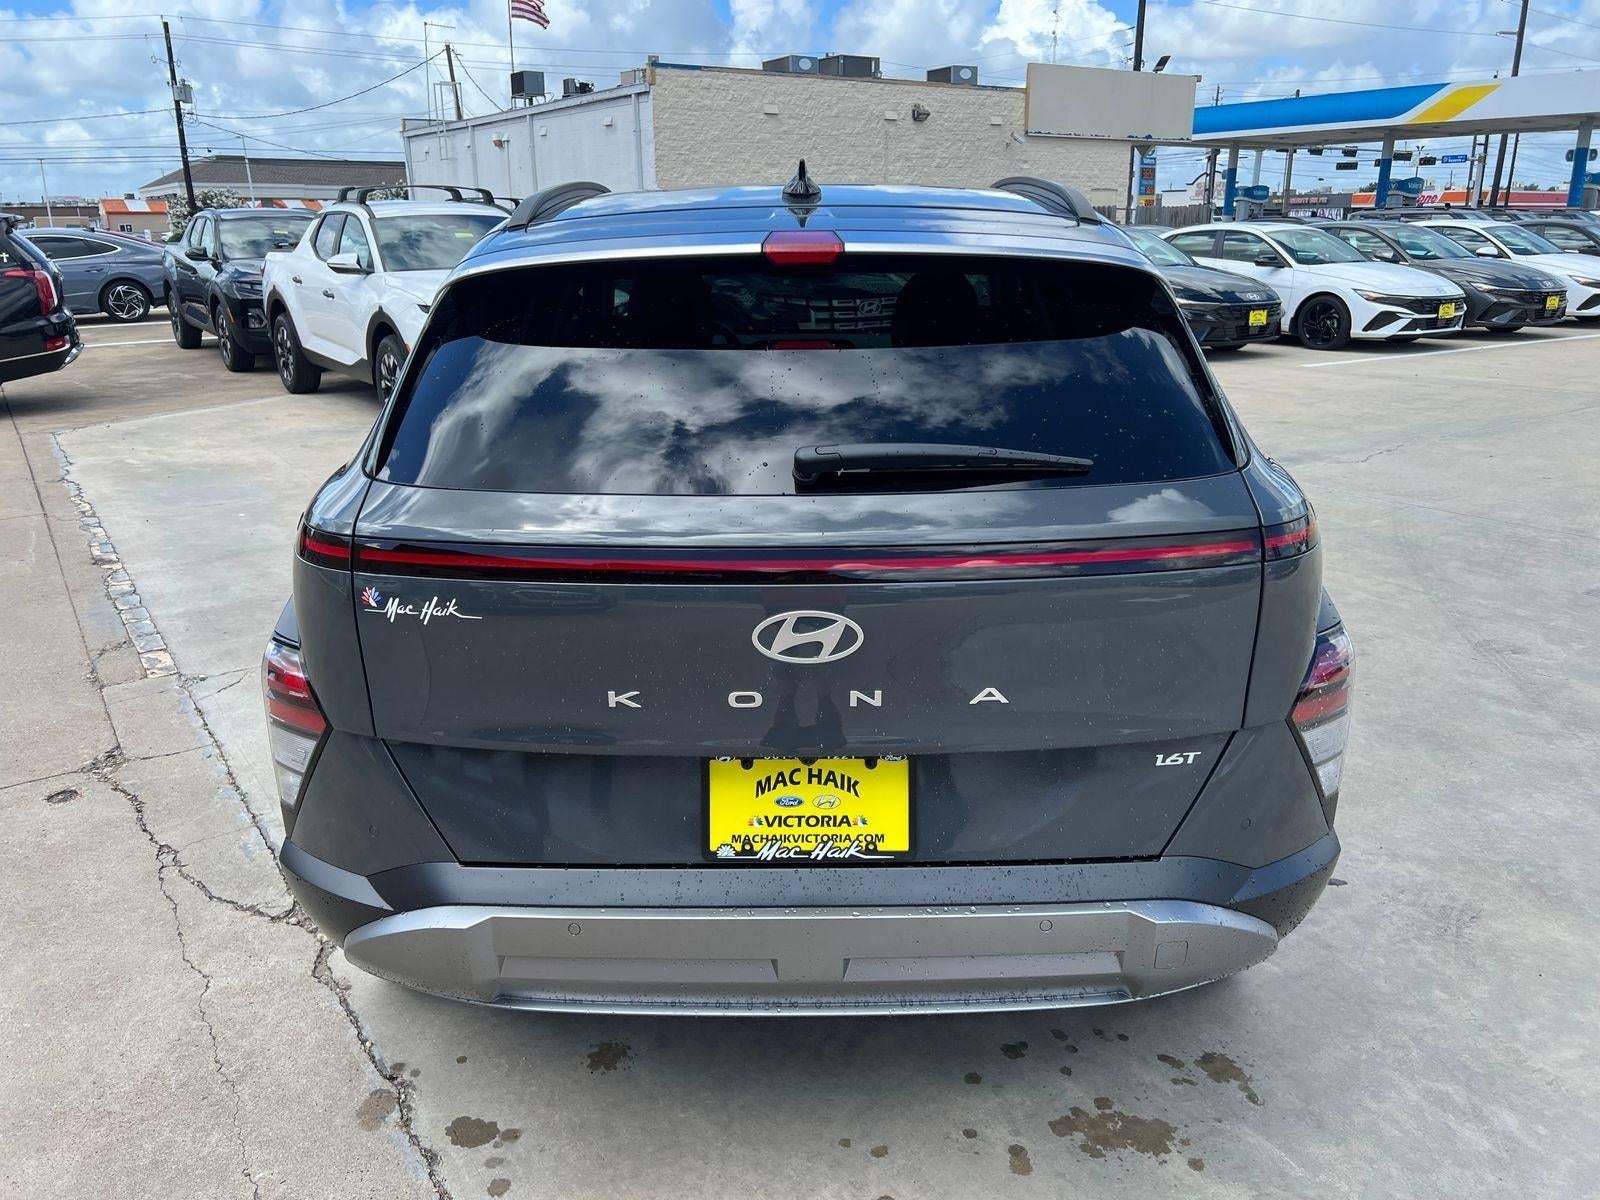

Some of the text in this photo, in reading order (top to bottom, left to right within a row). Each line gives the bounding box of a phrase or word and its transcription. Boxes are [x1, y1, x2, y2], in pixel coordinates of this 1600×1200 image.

[385, 596, 462, 626] Mac Haik
[755, 768, 861, 798] MAC HAIK
[777, 796, 801, 807] Ford
[762, 815, 852, 828] VICTORIA
[731, 833, 885, 844] MACHAIKVICTORIA.COM
[757, 840, 869, 860] Mac Haik
